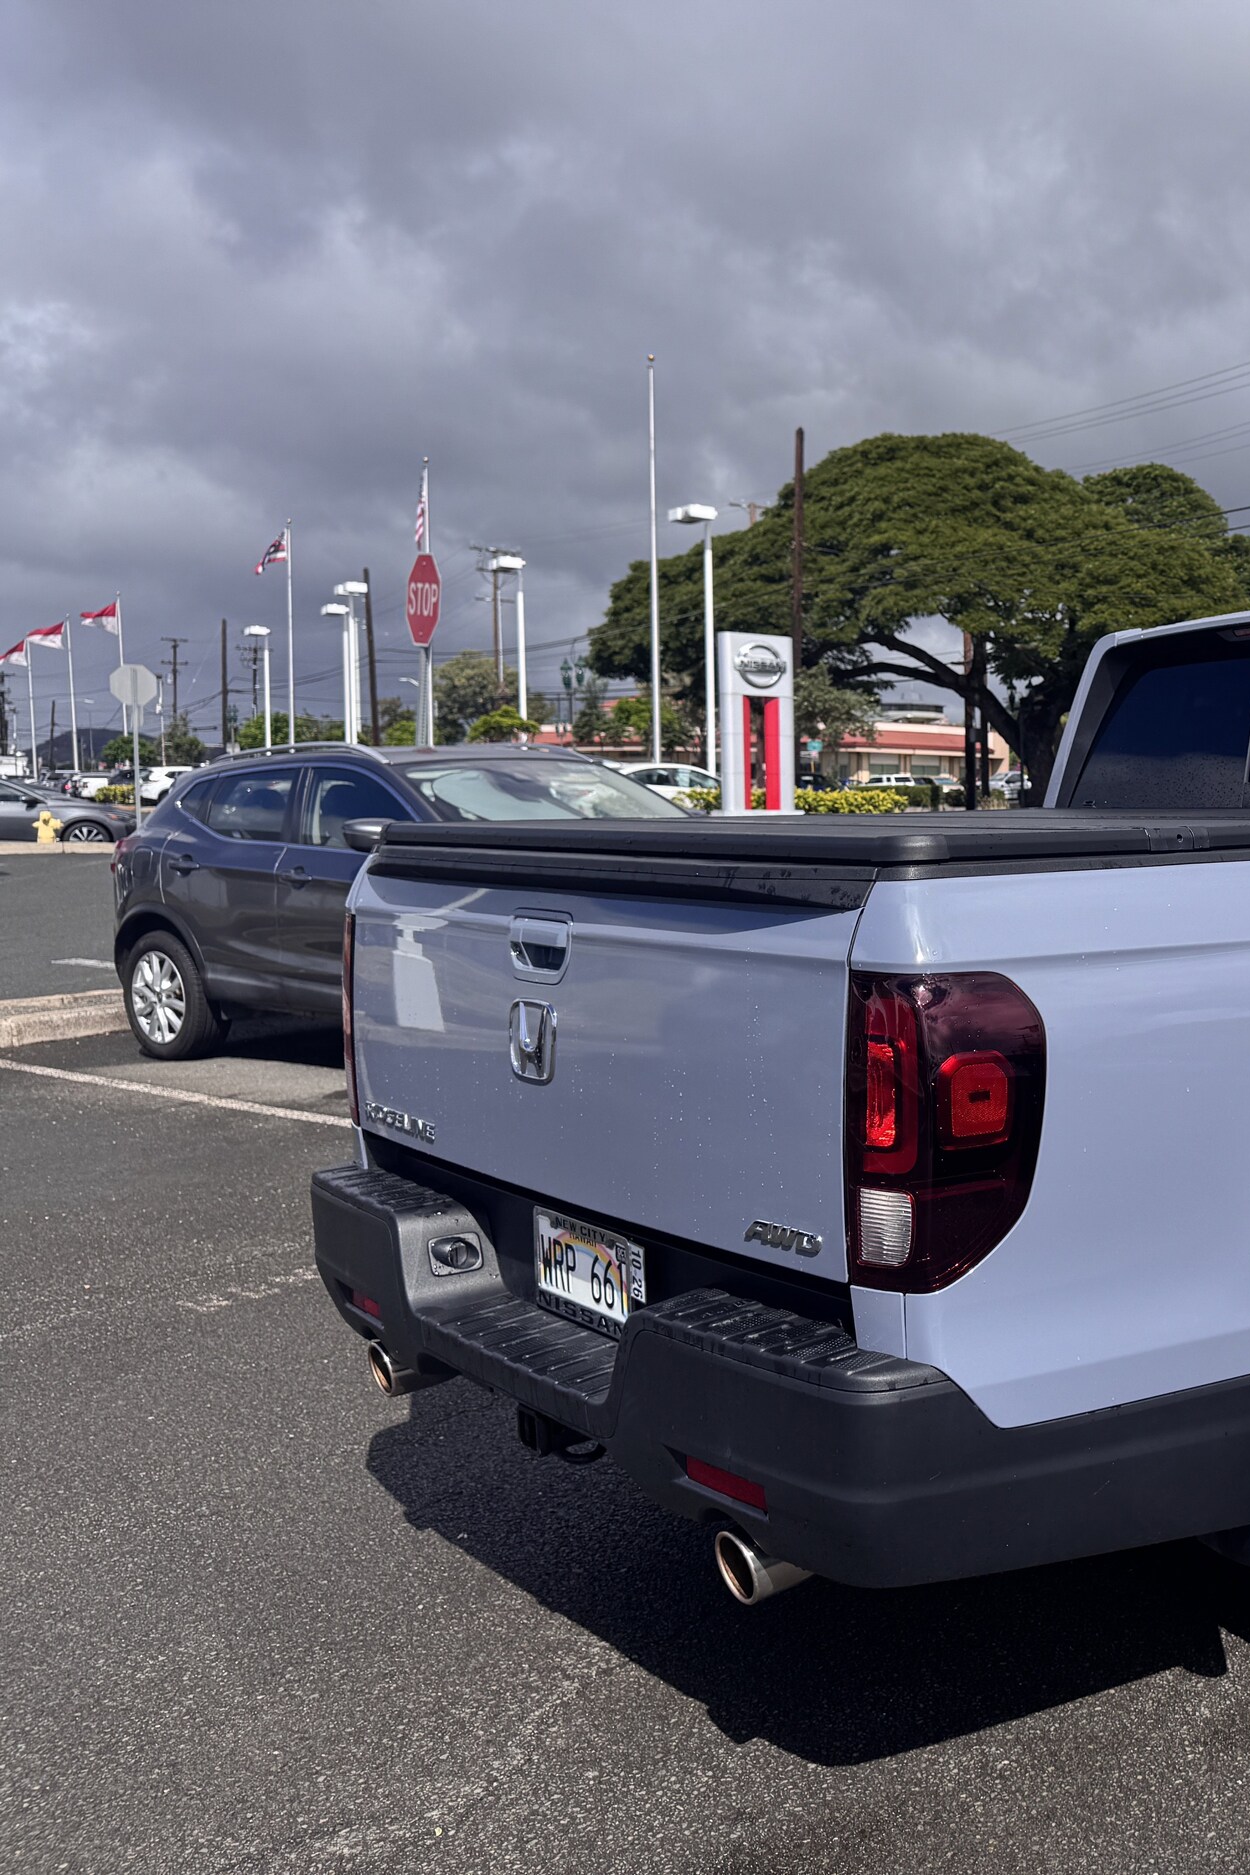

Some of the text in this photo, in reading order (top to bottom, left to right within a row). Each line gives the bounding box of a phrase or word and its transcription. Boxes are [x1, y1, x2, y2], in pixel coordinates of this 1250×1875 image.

[409, 582, 438, 617] STOP
[738, 660, 787, 672] NISSAN
[555, 1216, 605, 1242] NEW CITY
[743, 1219, 823, 1257] AWD
[541, 1234, 625, 1315] WRP 661
